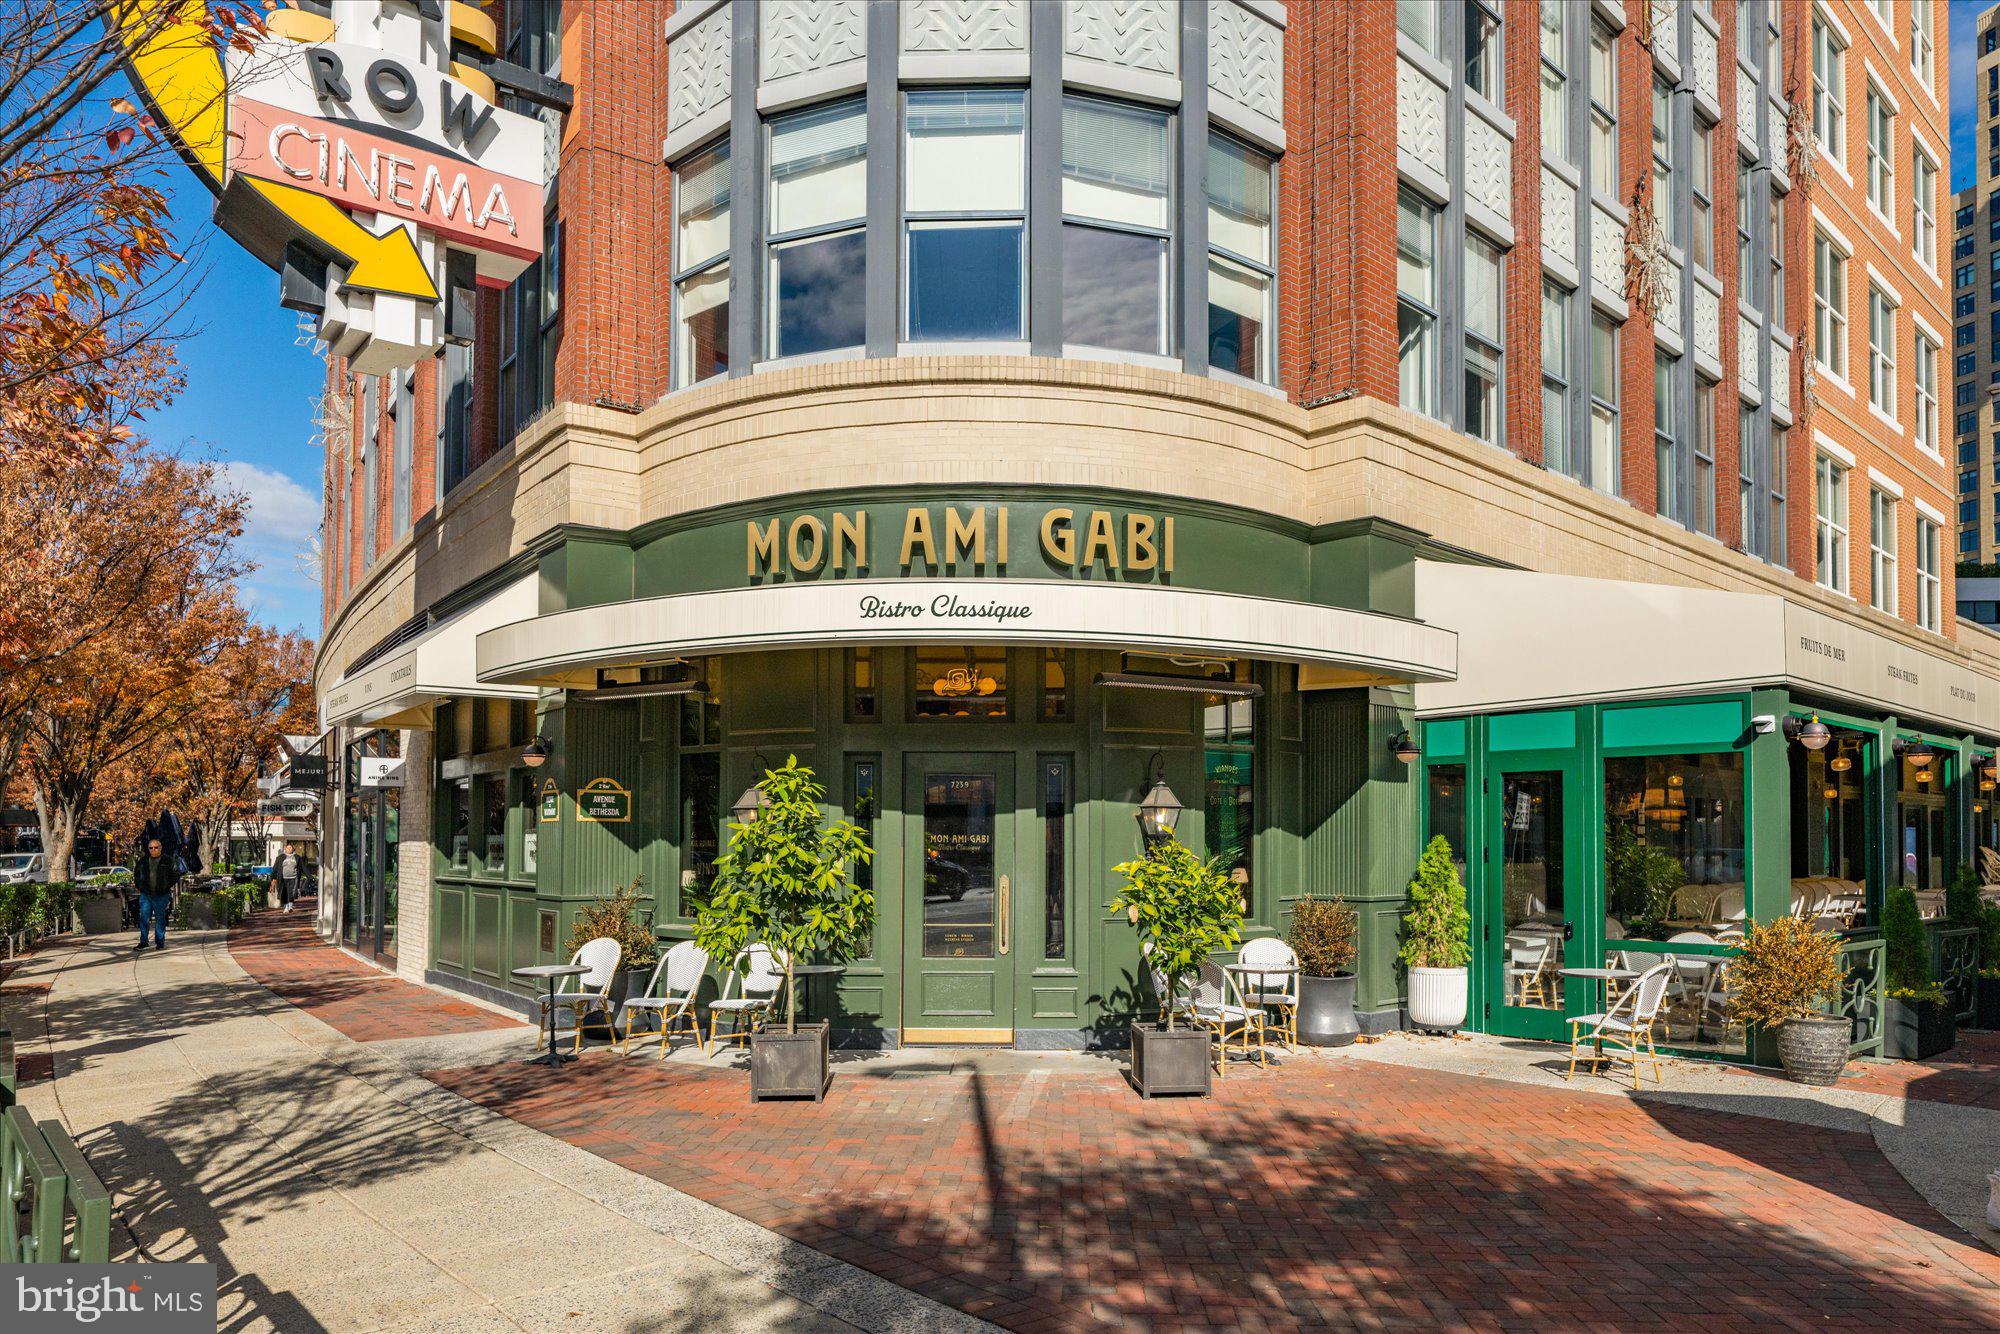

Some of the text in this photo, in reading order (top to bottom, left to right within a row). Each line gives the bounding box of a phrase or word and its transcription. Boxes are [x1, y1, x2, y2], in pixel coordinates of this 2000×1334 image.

[305, 47, 496, 146] ROW
[268, 123, 518, 237] CINEMA
[747, 507, 1175, 579] MON AMI GABI
[859, 594, 1033, 623] Bistro Classique
[1800, 636, 1846, 661] FRUITS DE MER
[1887, 665, 1919, 685] STEAK FRITES
[261, 804, 282, 812] FISH
[592, 795, 616, 804] AVENUE
[589, 808, 620, 816] BETHESDA
[930, 834, 990, 844] MON AMI GABI
